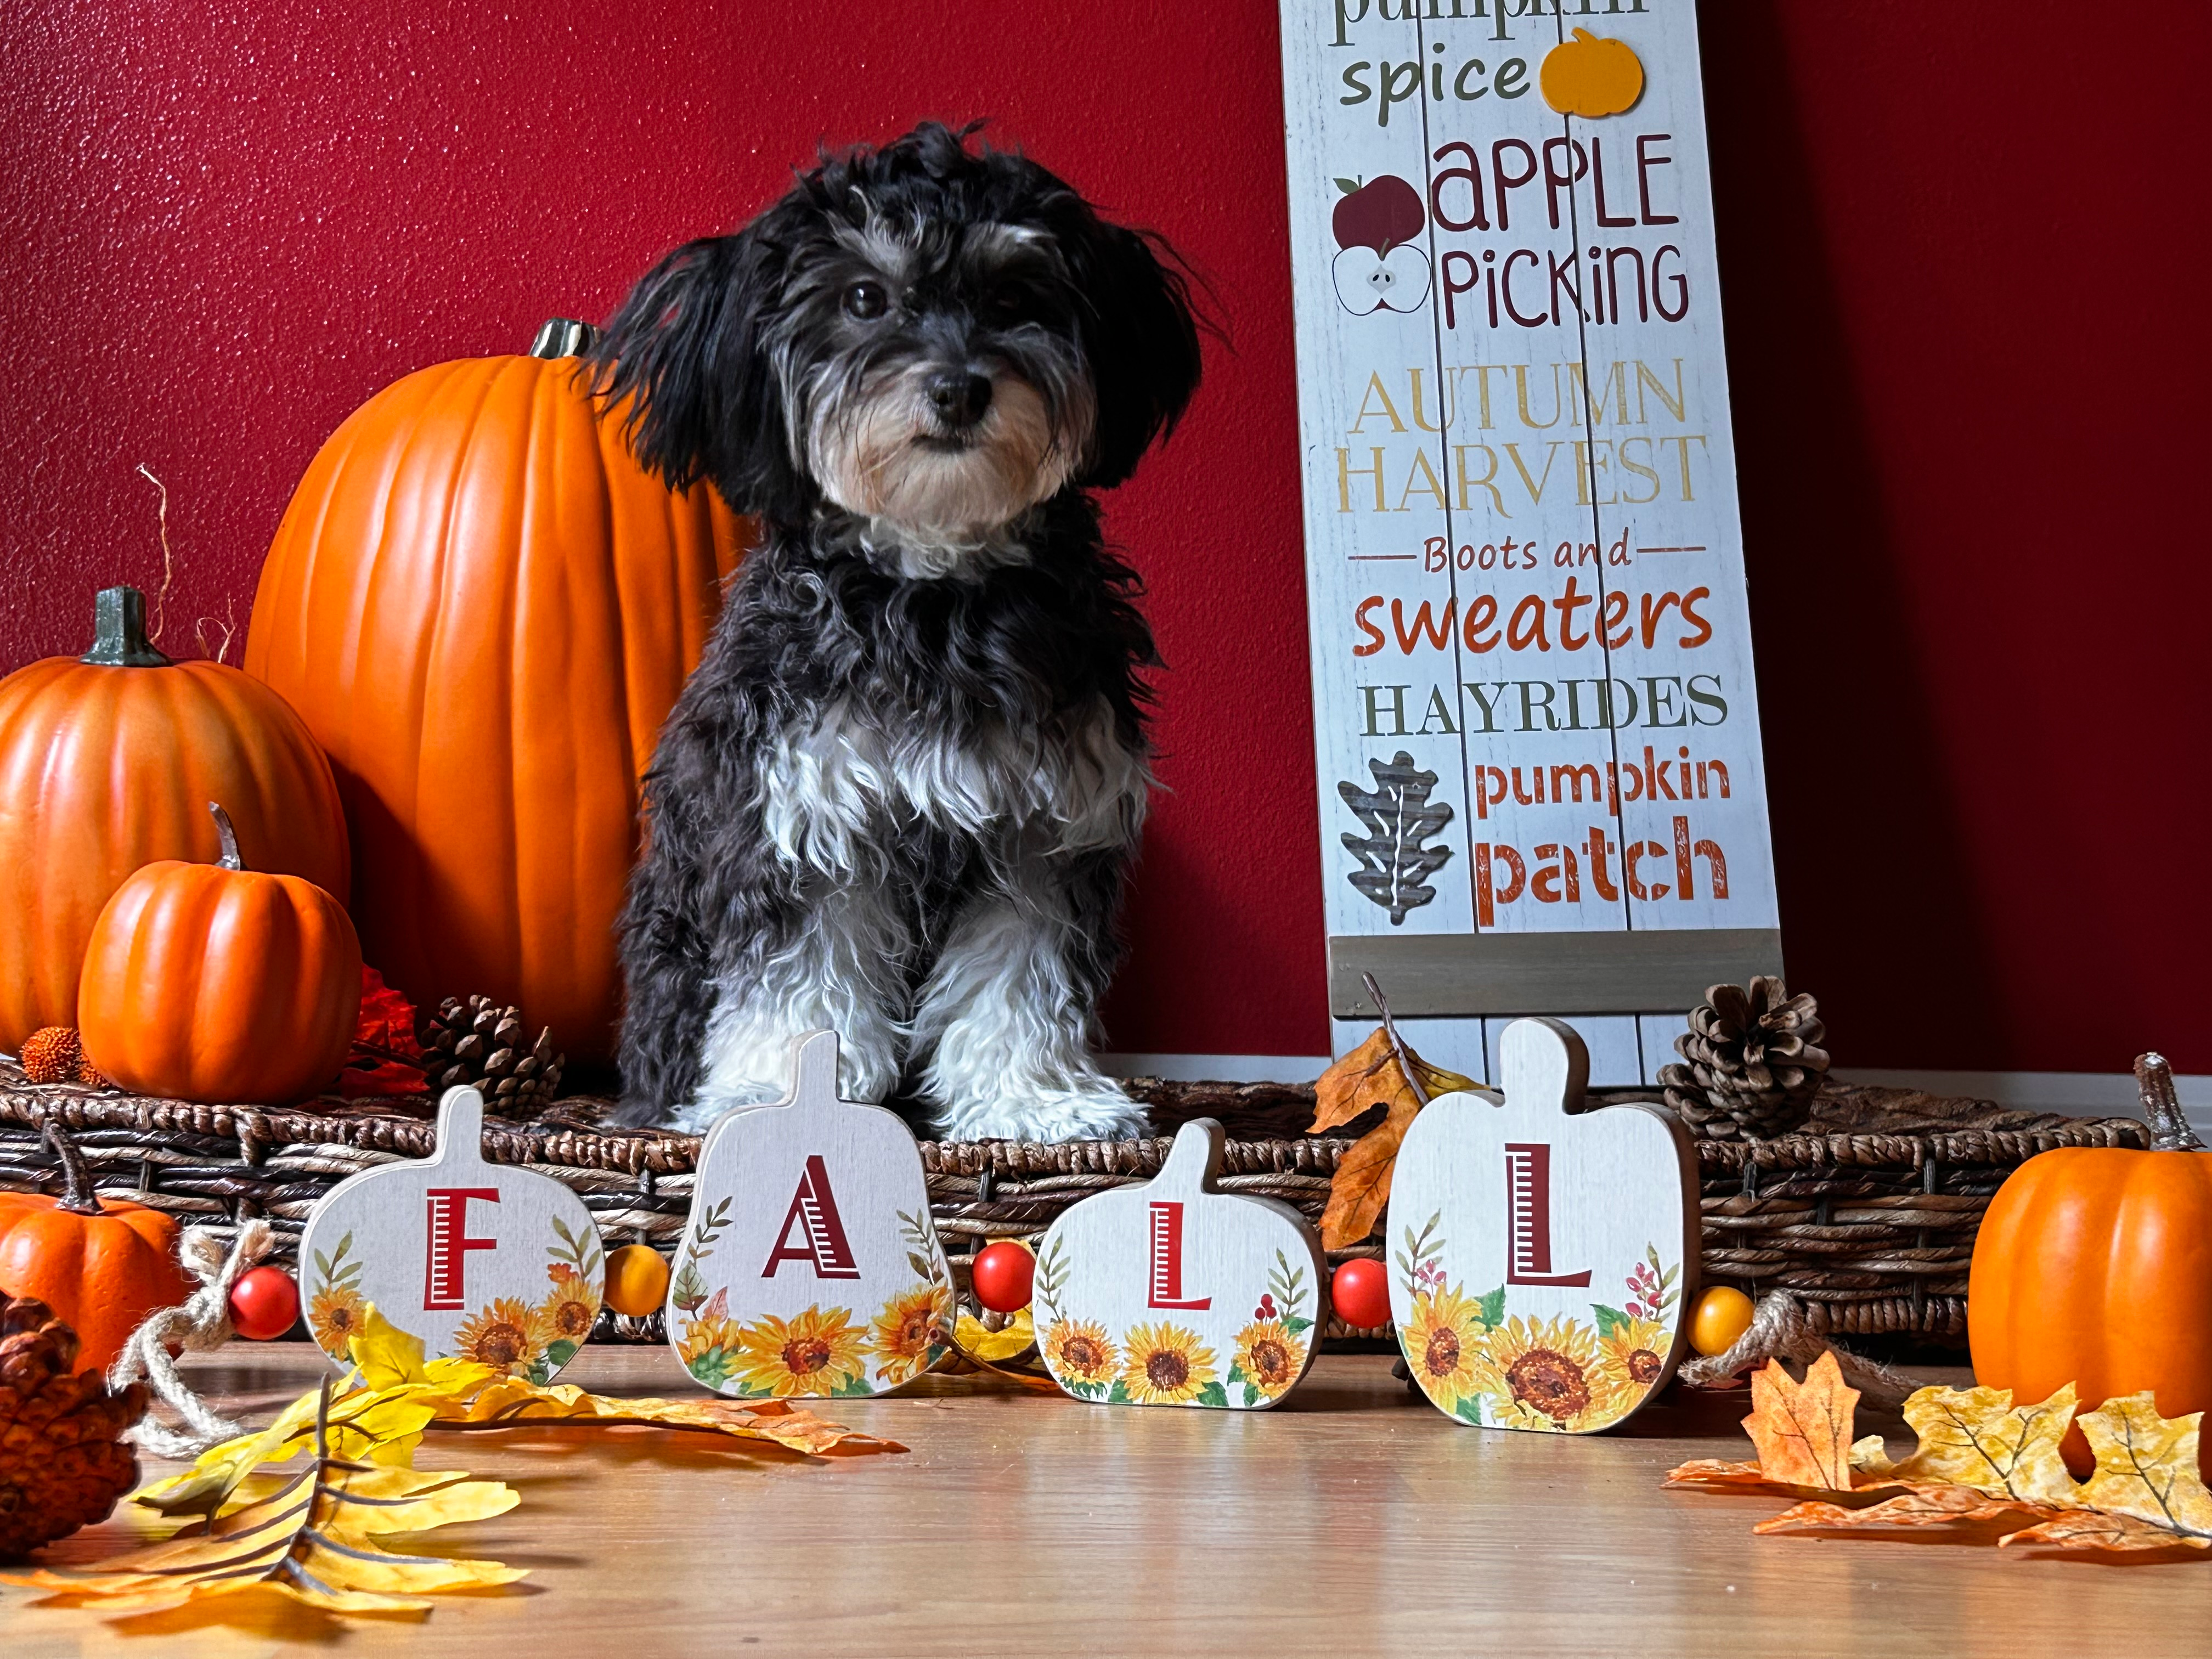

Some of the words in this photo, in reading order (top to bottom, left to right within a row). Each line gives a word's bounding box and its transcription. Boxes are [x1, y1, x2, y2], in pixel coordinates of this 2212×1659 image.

[1340, 42, 1530, 127] spice
[1347, 358, 1686, 434] AUTUMN
[1335, 435, 1706, 518] HARVEST
[1424, 535, 1537, 573] Boots
[1554, 527, 1632, 568] and
[1352, 575, 1712, 657] sweaters
[1357, 674, 1728, 736] HAYRIDES
[1475, 745, 1730, 820] pumpkin
[1474, 815, 1729, 927] patch
